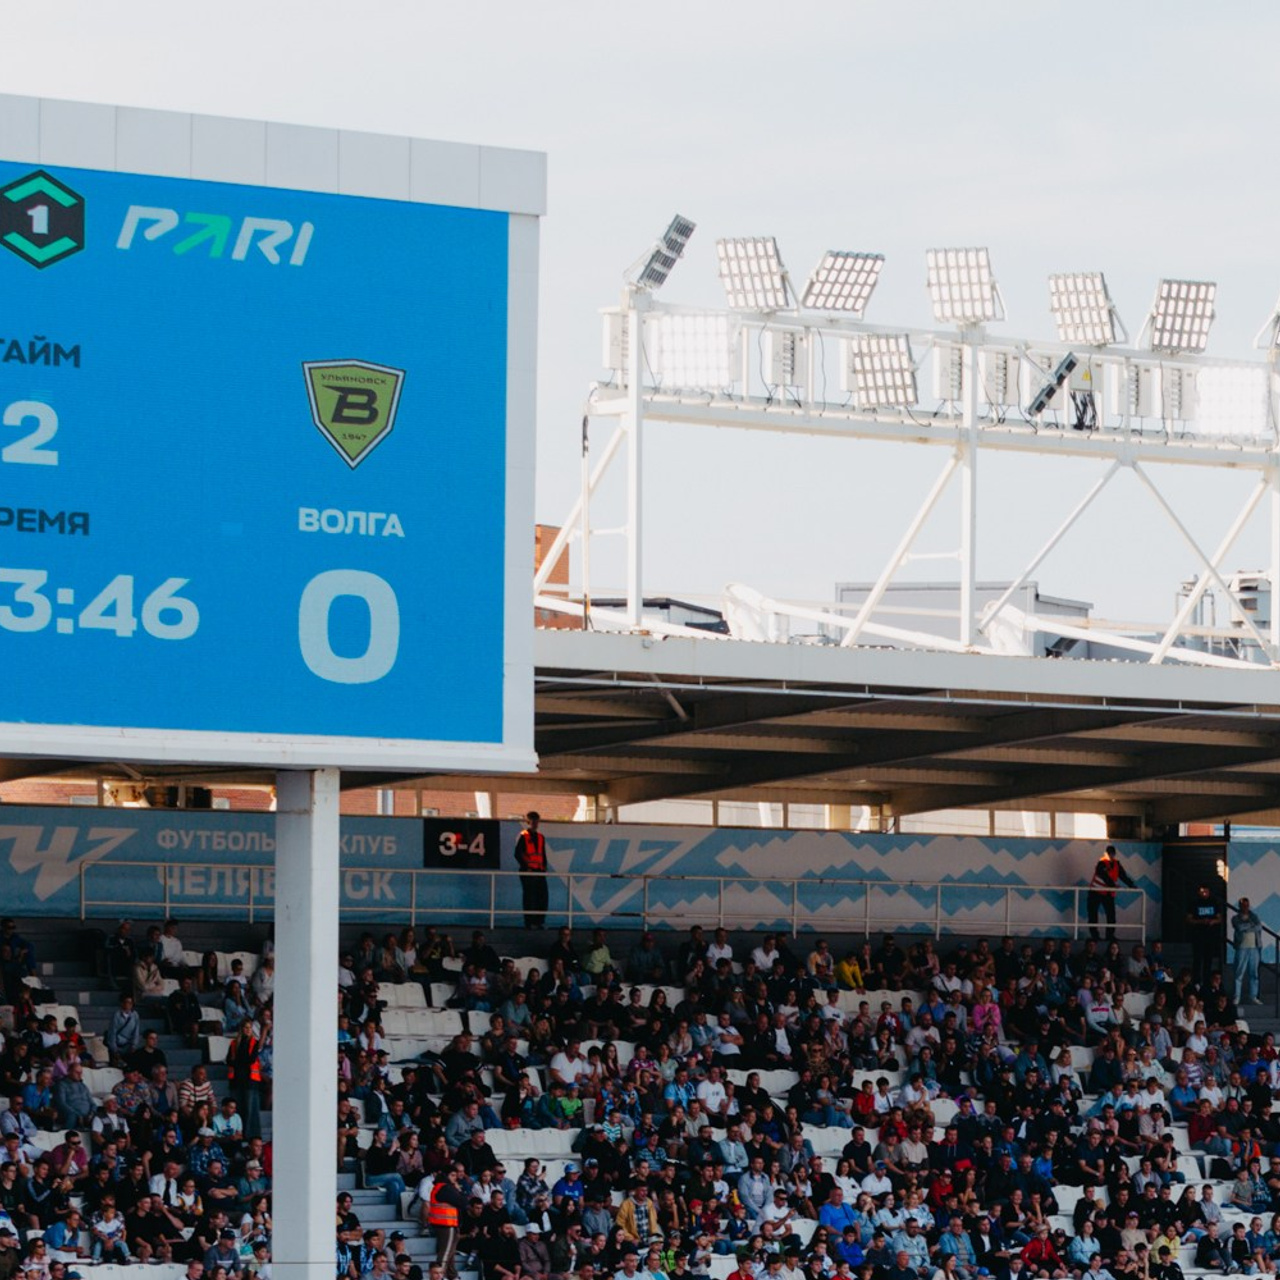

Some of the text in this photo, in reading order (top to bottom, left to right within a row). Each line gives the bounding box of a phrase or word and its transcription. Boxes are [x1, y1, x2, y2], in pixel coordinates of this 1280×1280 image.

[27, 204, 49, 235] 1
[116, 204, 314, 266] PARI
[0, 335, 81, 368] АЙМ
[2, 400, 58, 466] 2
[298, 507, 406, 538] ВОЛГА
[298, 568, 400, 685] 0
[438, 832, 486, 858] 3-4
